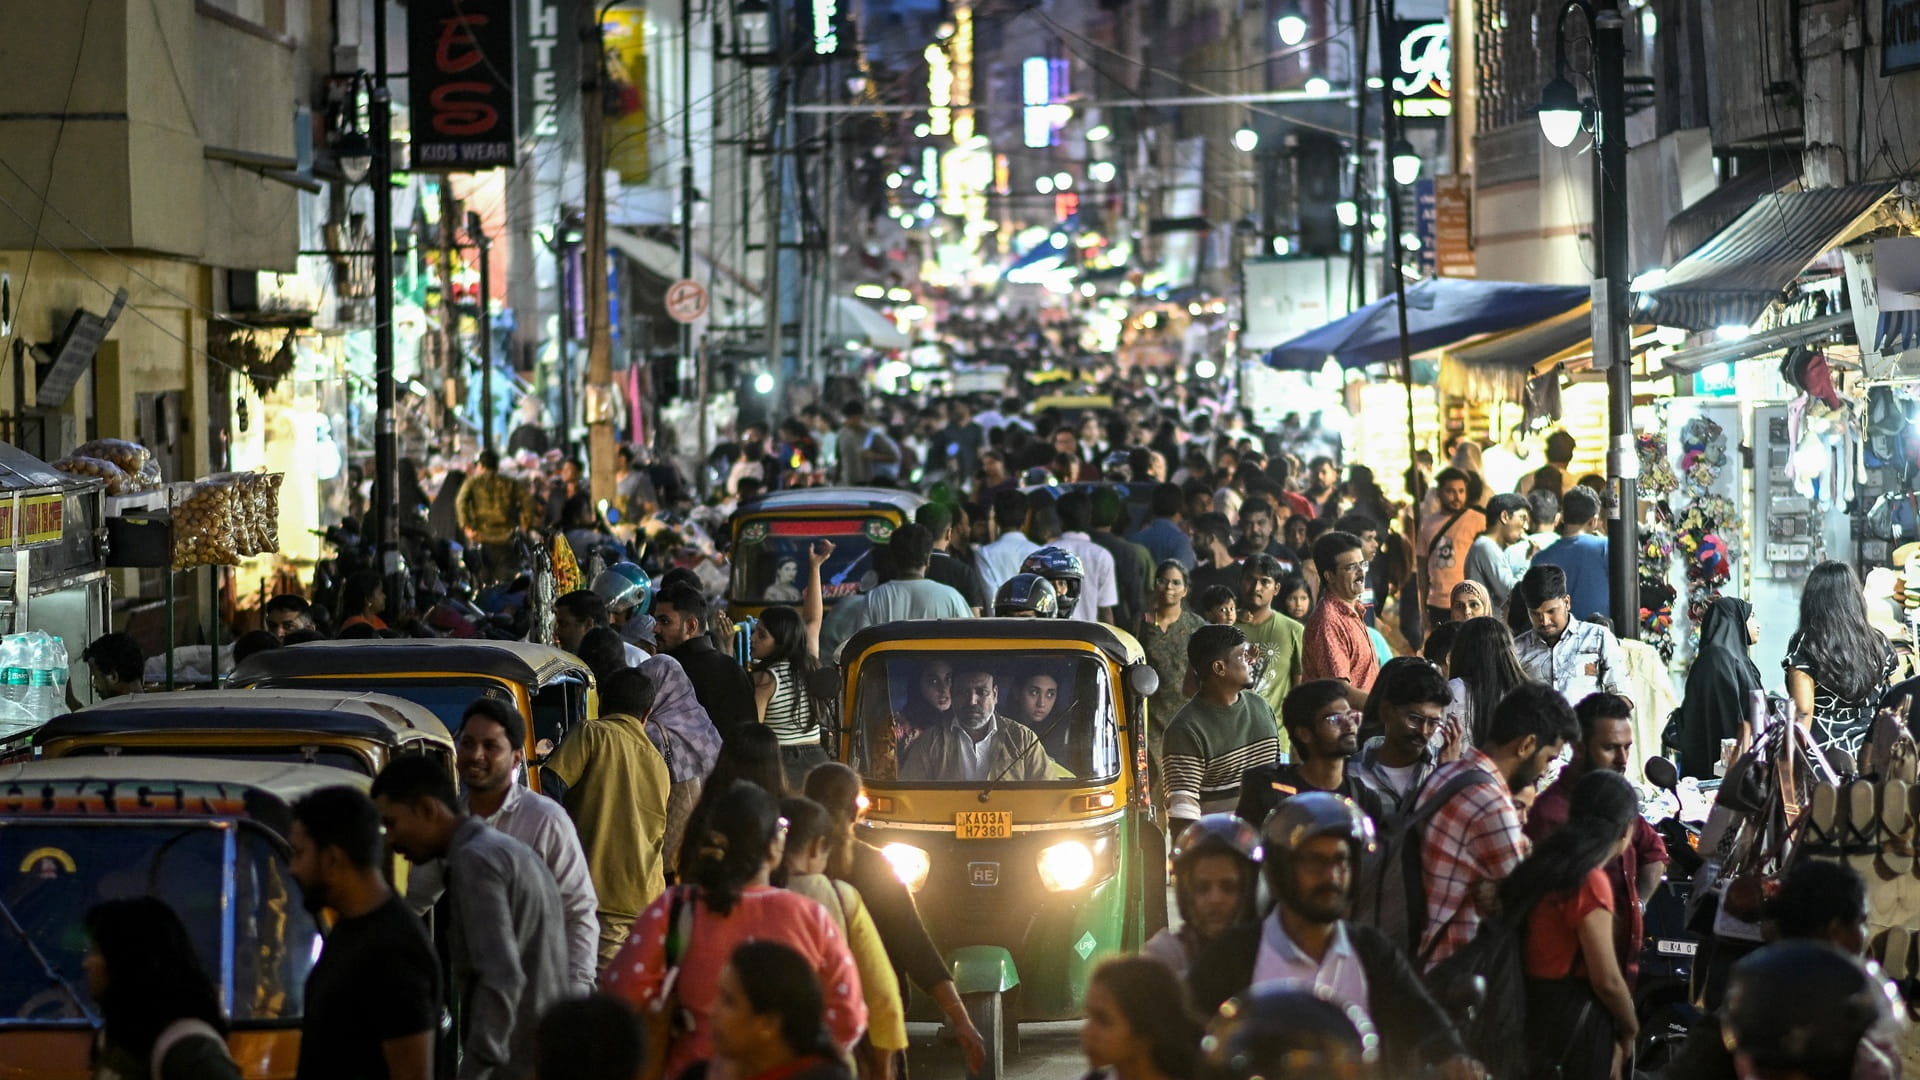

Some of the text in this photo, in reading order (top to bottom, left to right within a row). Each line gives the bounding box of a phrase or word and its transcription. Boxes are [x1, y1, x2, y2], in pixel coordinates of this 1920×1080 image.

[420, 143, 508, 161] KIDS WEAR
[965, 812, 1004, 825] KA03A
[965, 825, 1004, 837] H7380
[974, 869, 994, 881] RE
